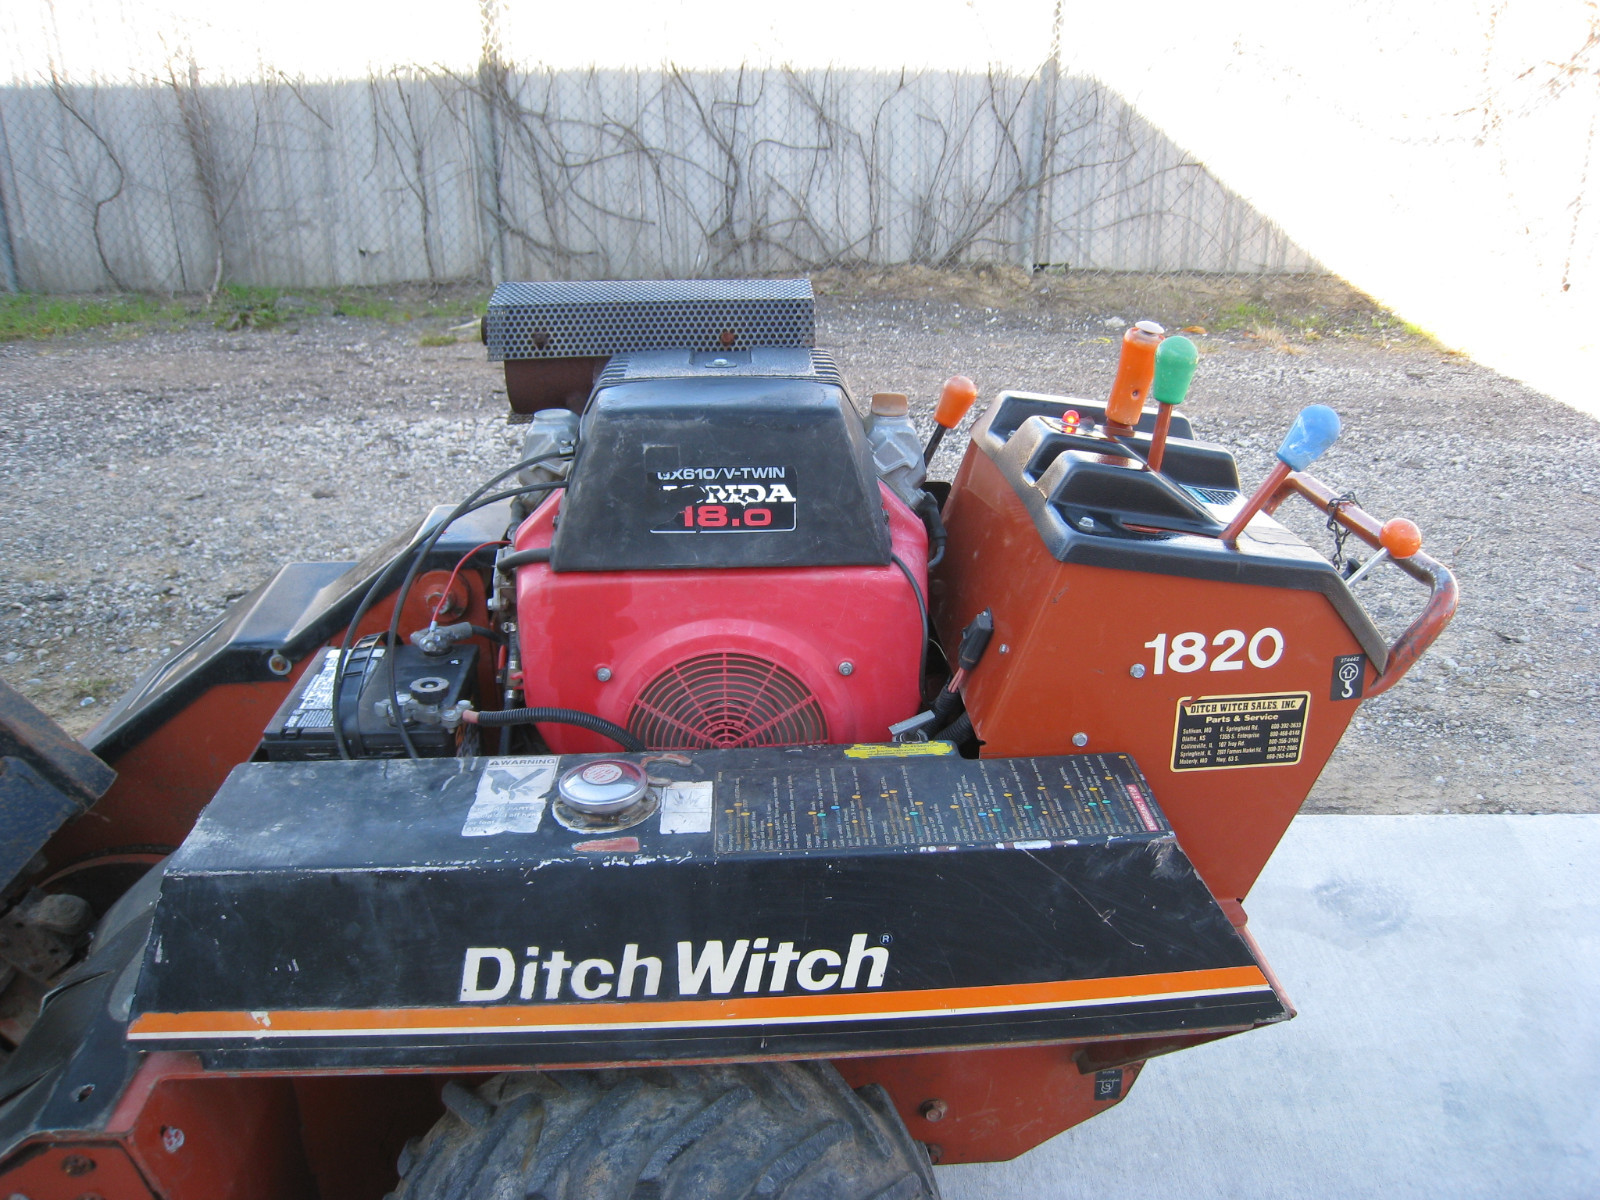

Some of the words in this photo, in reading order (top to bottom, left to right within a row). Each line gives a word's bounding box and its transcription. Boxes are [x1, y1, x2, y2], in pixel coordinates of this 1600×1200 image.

[680, 505, 773, 527] 18.0
[1144, 627, 1284, 675] 1820
[1190, 704, 1217, 714] DITCH
[1219, 702, 1249, 712] WITCH
[1206, 715, 1231, 723] Parts
[1233, 714, 1241, 722] &
[1244, 713, 1279, 722] Service
[500, 758, 556, 766] WARNING
[1126, 785, 1140, 799] STOP
[1135, 800, 1157, 830] EMERGENCY
[459, 943, 662, 1001] Ditch
[677, 933, 889, 995] Witch
